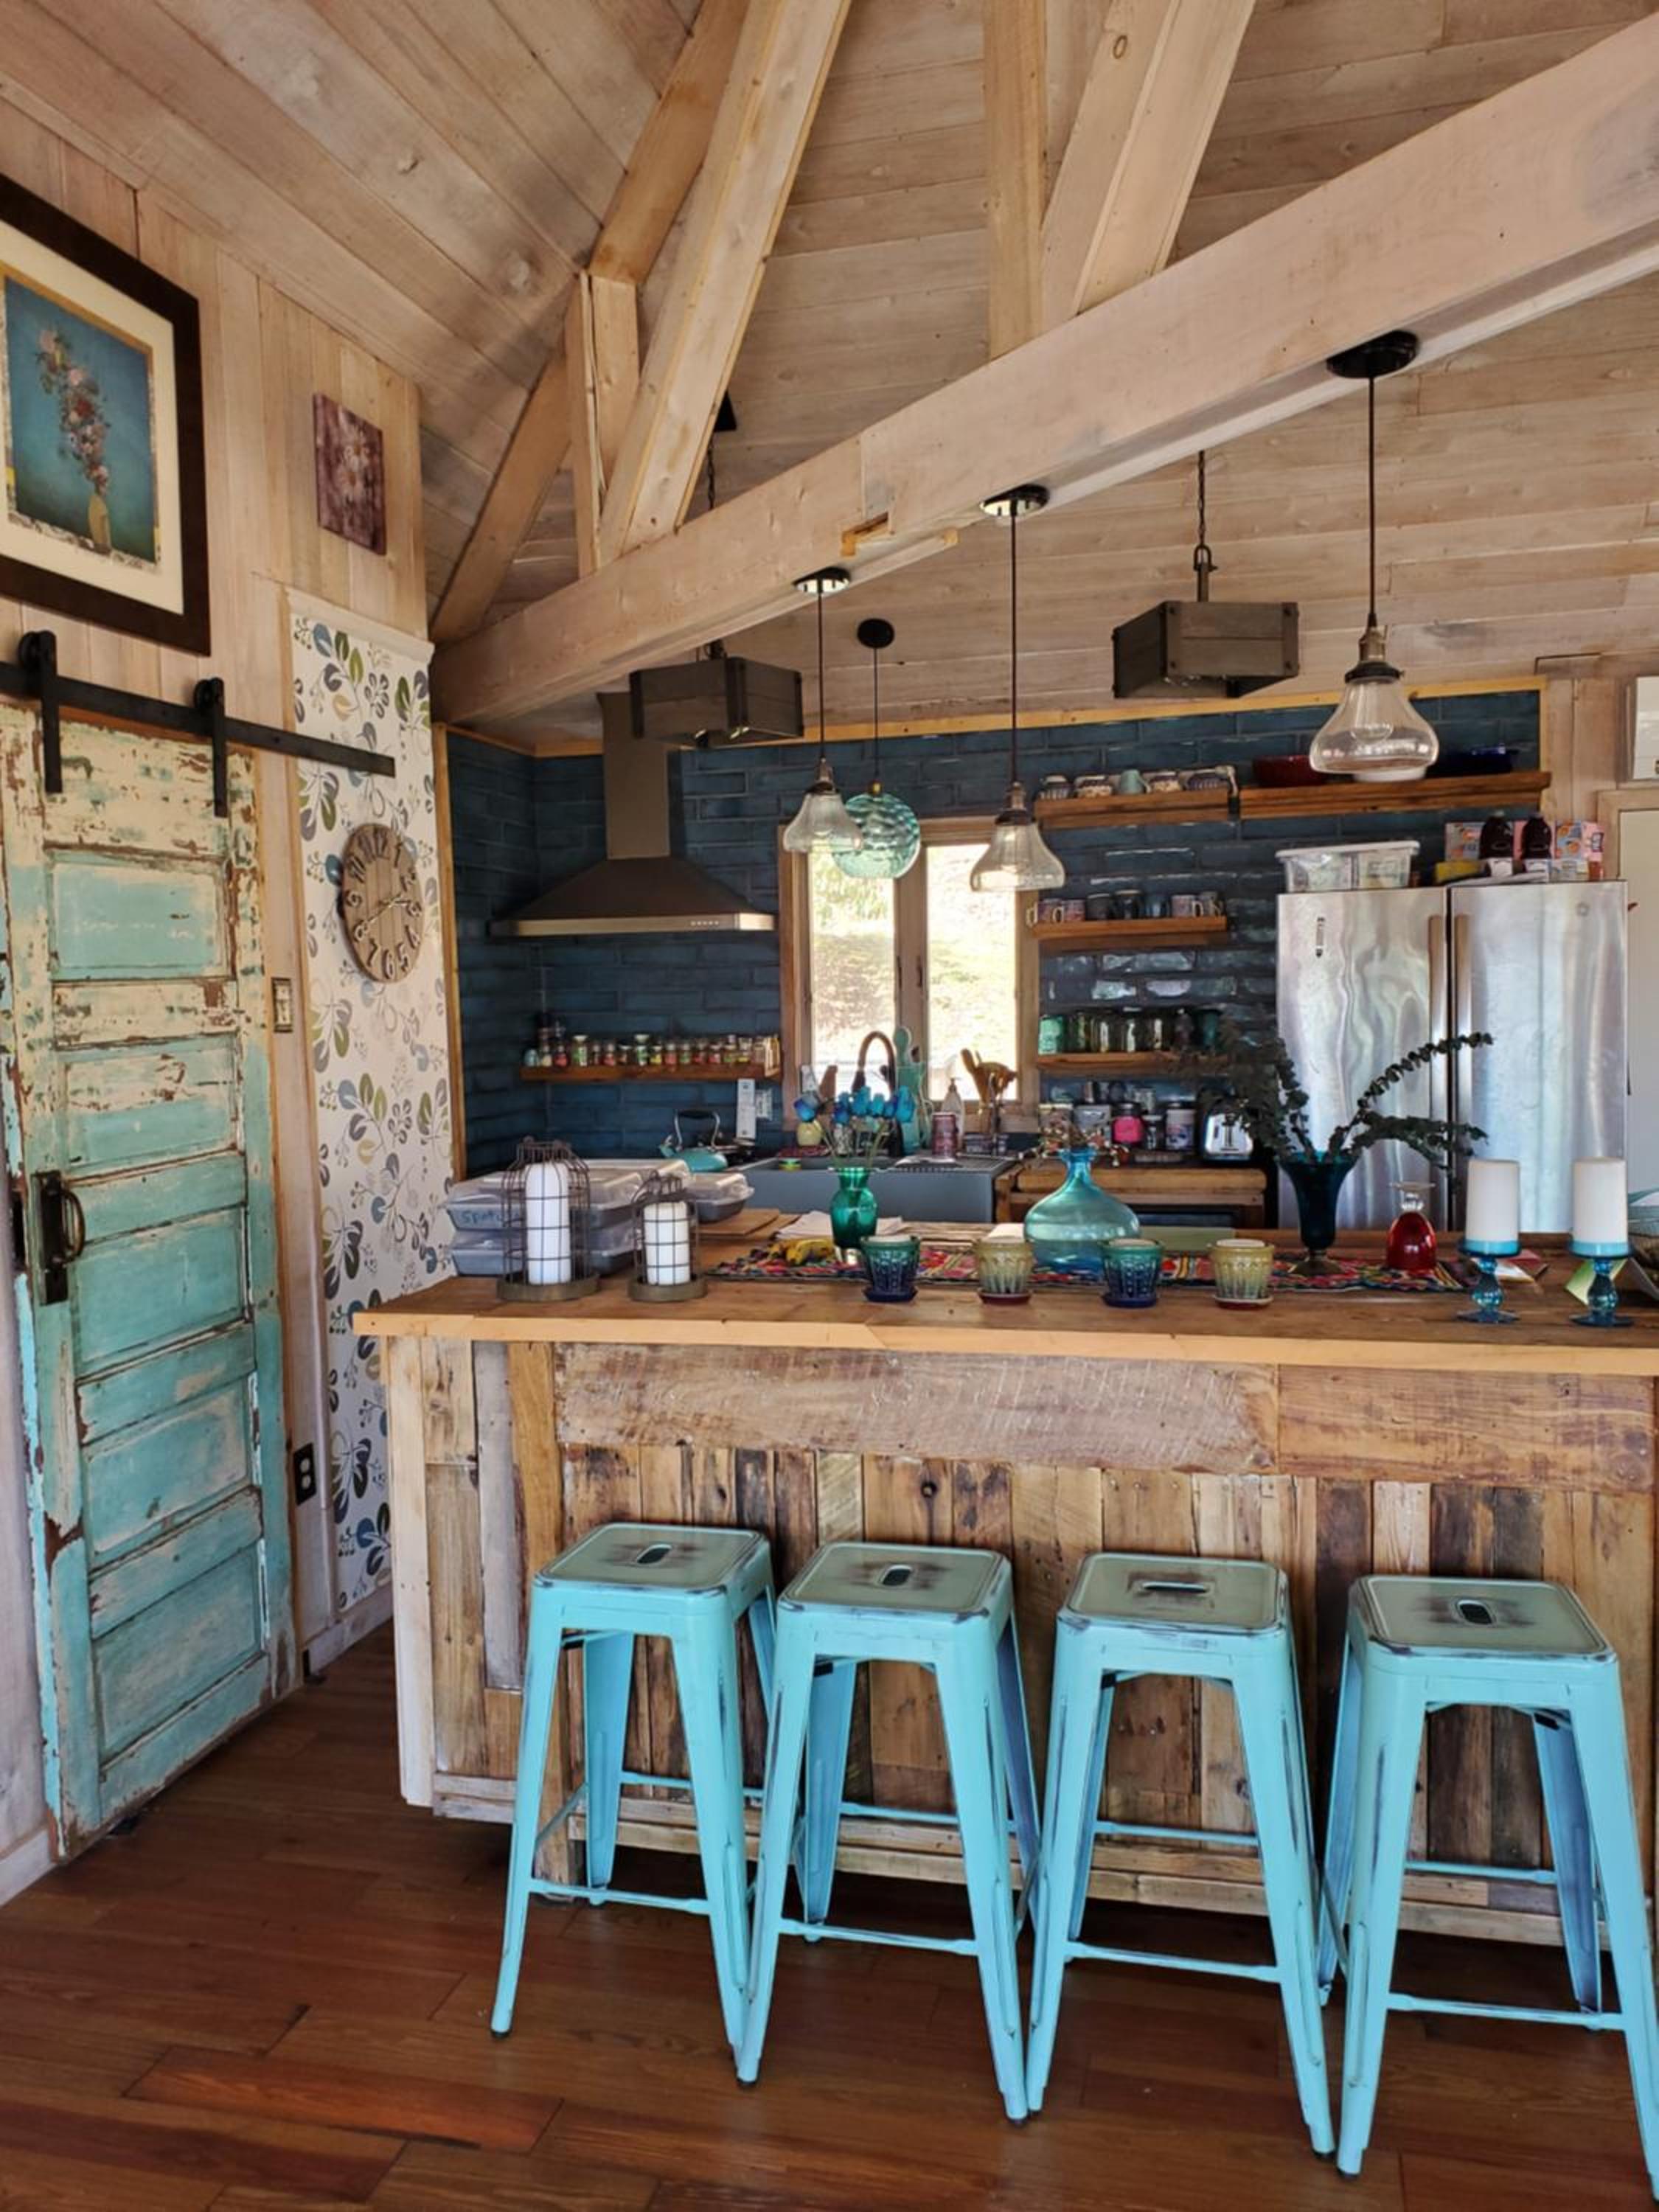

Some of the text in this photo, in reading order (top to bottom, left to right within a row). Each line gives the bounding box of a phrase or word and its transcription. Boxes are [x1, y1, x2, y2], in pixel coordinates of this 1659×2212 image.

[393, 840, 403, 869] 1
[400, 866, 417, 892] 2
[344, 889, 362, 908] 9
[406, 901, 422, 918] 3
[353, 919, 369, 943] 8
[406, 924, 421, 950] 4
[367, 937, 379, 967] 7
[382, 948, 394, 980] 6
[396, 941, 409, 973] 5
